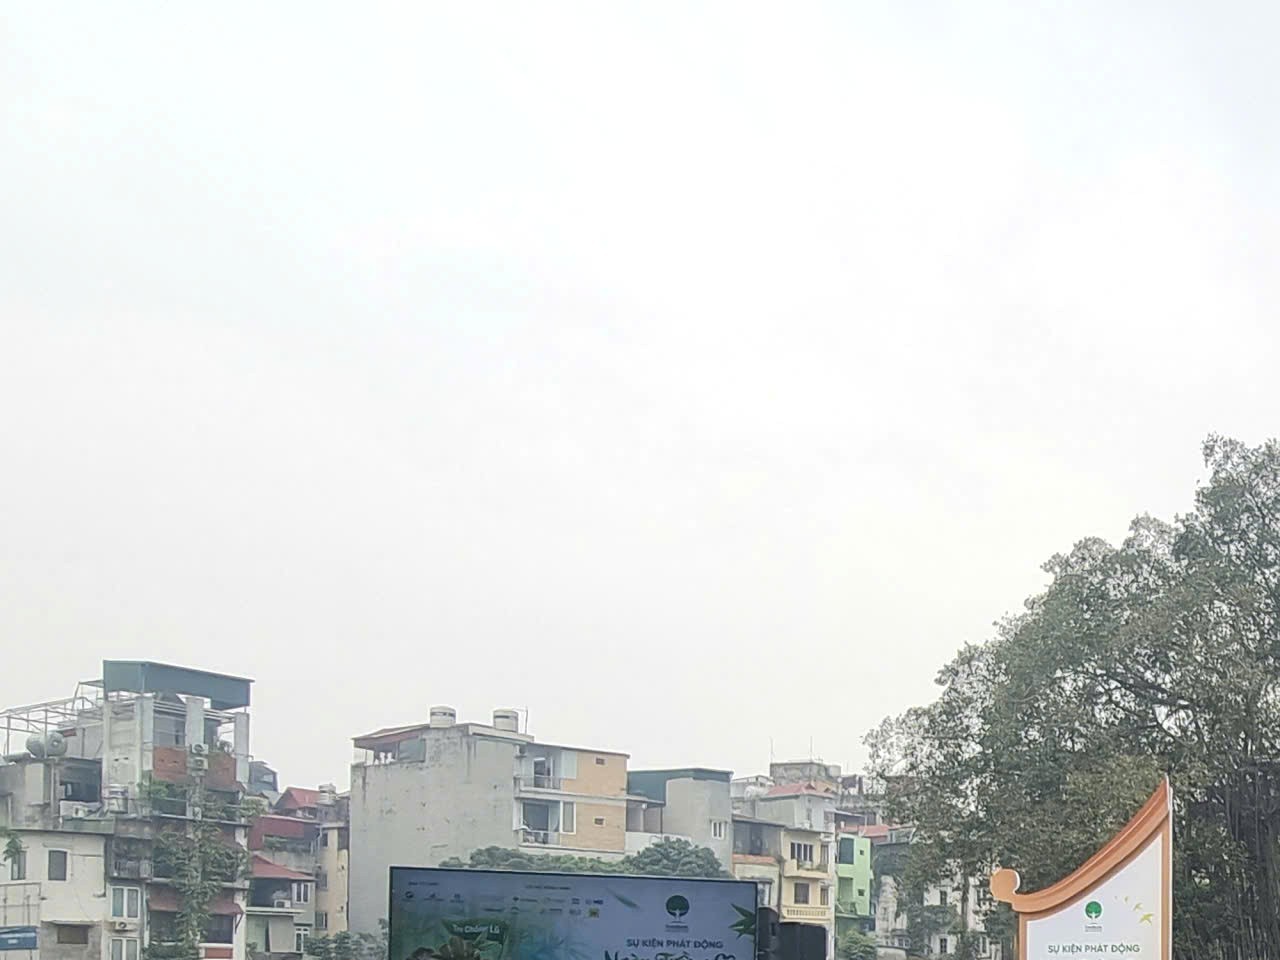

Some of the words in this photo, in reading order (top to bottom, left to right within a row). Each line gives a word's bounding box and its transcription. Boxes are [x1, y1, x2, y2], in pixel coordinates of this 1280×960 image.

[694, 939, 724, 949] ĐỘNG
[1062, 943, 1082, 954] KIỆN
[1111, 942, 1140, 954] ĐỘNG
